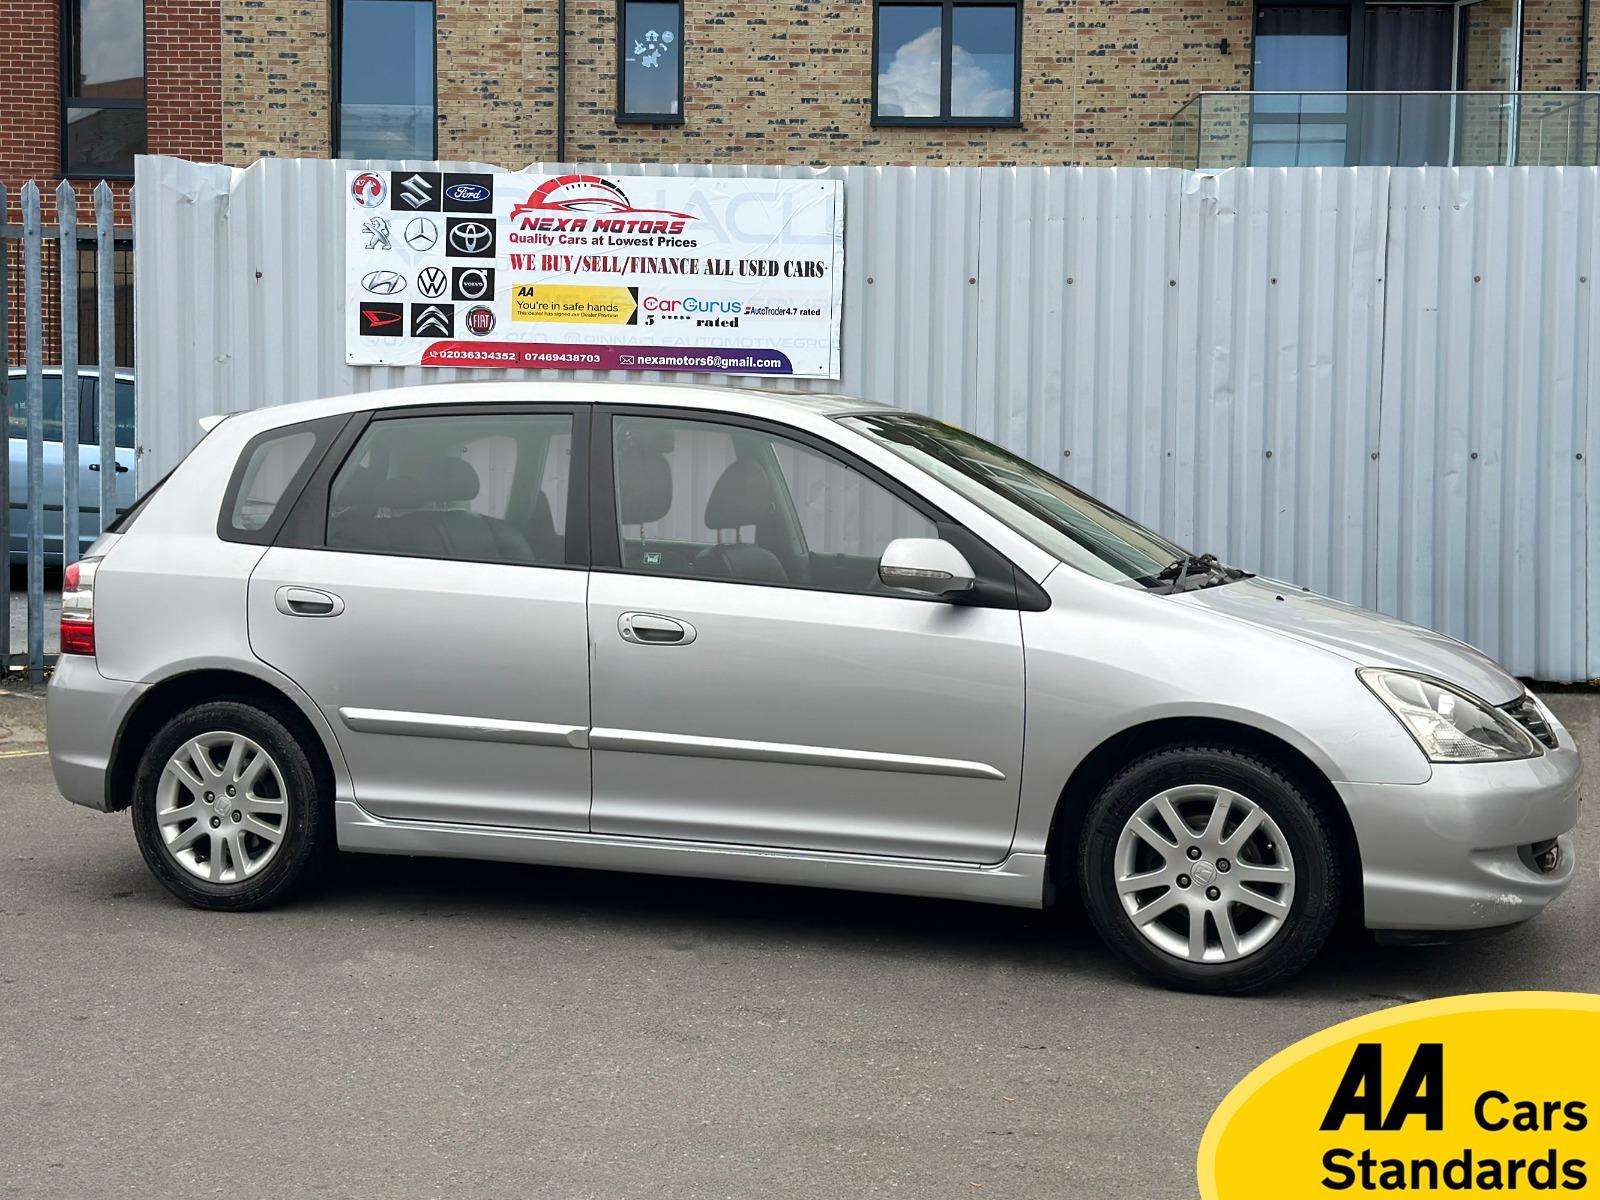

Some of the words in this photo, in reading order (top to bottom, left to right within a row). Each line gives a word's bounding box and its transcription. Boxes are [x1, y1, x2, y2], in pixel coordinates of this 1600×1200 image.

[454, 187, 482, 199] Ford
[520, 218, 587, 232] NEXA
[592, 219, 686, 235] MOTORS
[509, 233, 554, 246] Quality
[558, 234, 587, 245] Cars
[591, 235, 604, 246] at
[608, 235, 654, 247] Lowest
[657, 236, 697, 248] Prices
[509, 253, 536, 271] WE
[703, 258, 734, 276] ALL
[739, 259, 780, 277] USED
[518, 286, 534, 297] AA
[516, 300, 549, 310] You're
[551, 301, 560, 310] in
[563, 302, 585, 311] safe
[587, 303, 619, 312] hands
[643, 296, 742, 313] CarGurus
[799, 308, 821, 316] rated
[473, 314, 490, 328] FIAT
[645, 314, 655, 326] 5
[696, 317, 739, 328] rated
[440, 351, 516, 361] 02036334352
[524, 352, 601, 362] 07469438703
[637, 356, 782, 369] nexamotors6@gmail.com
